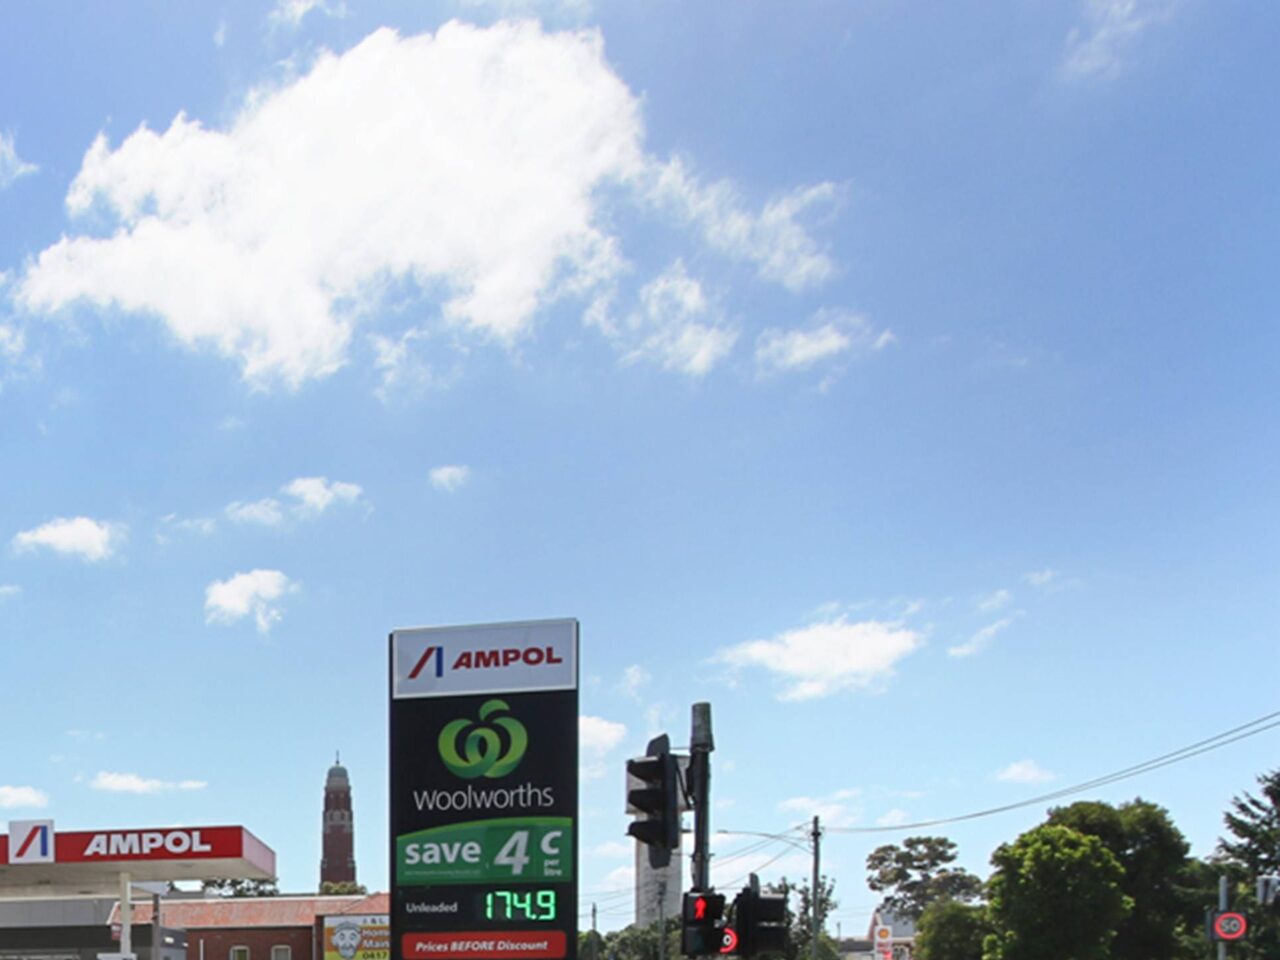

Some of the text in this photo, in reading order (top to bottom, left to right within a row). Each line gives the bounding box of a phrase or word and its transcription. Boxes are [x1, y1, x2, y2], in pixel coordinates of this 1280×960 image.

[451, 646, 563, 670] AMPOL
[413, 782, 555, 811] Woolworths
[83, 831, 212, 856] AMPOL
[405, 841, 482, 865] save
[493, 830, 530, 875] 4
[544, 858, 560, 868] per
[544, 868, 563, 877] litre
[406, 890, 556, 920] Unleaded 174.9
[415, 940, 549, 952] Prices BEFORE Discount
